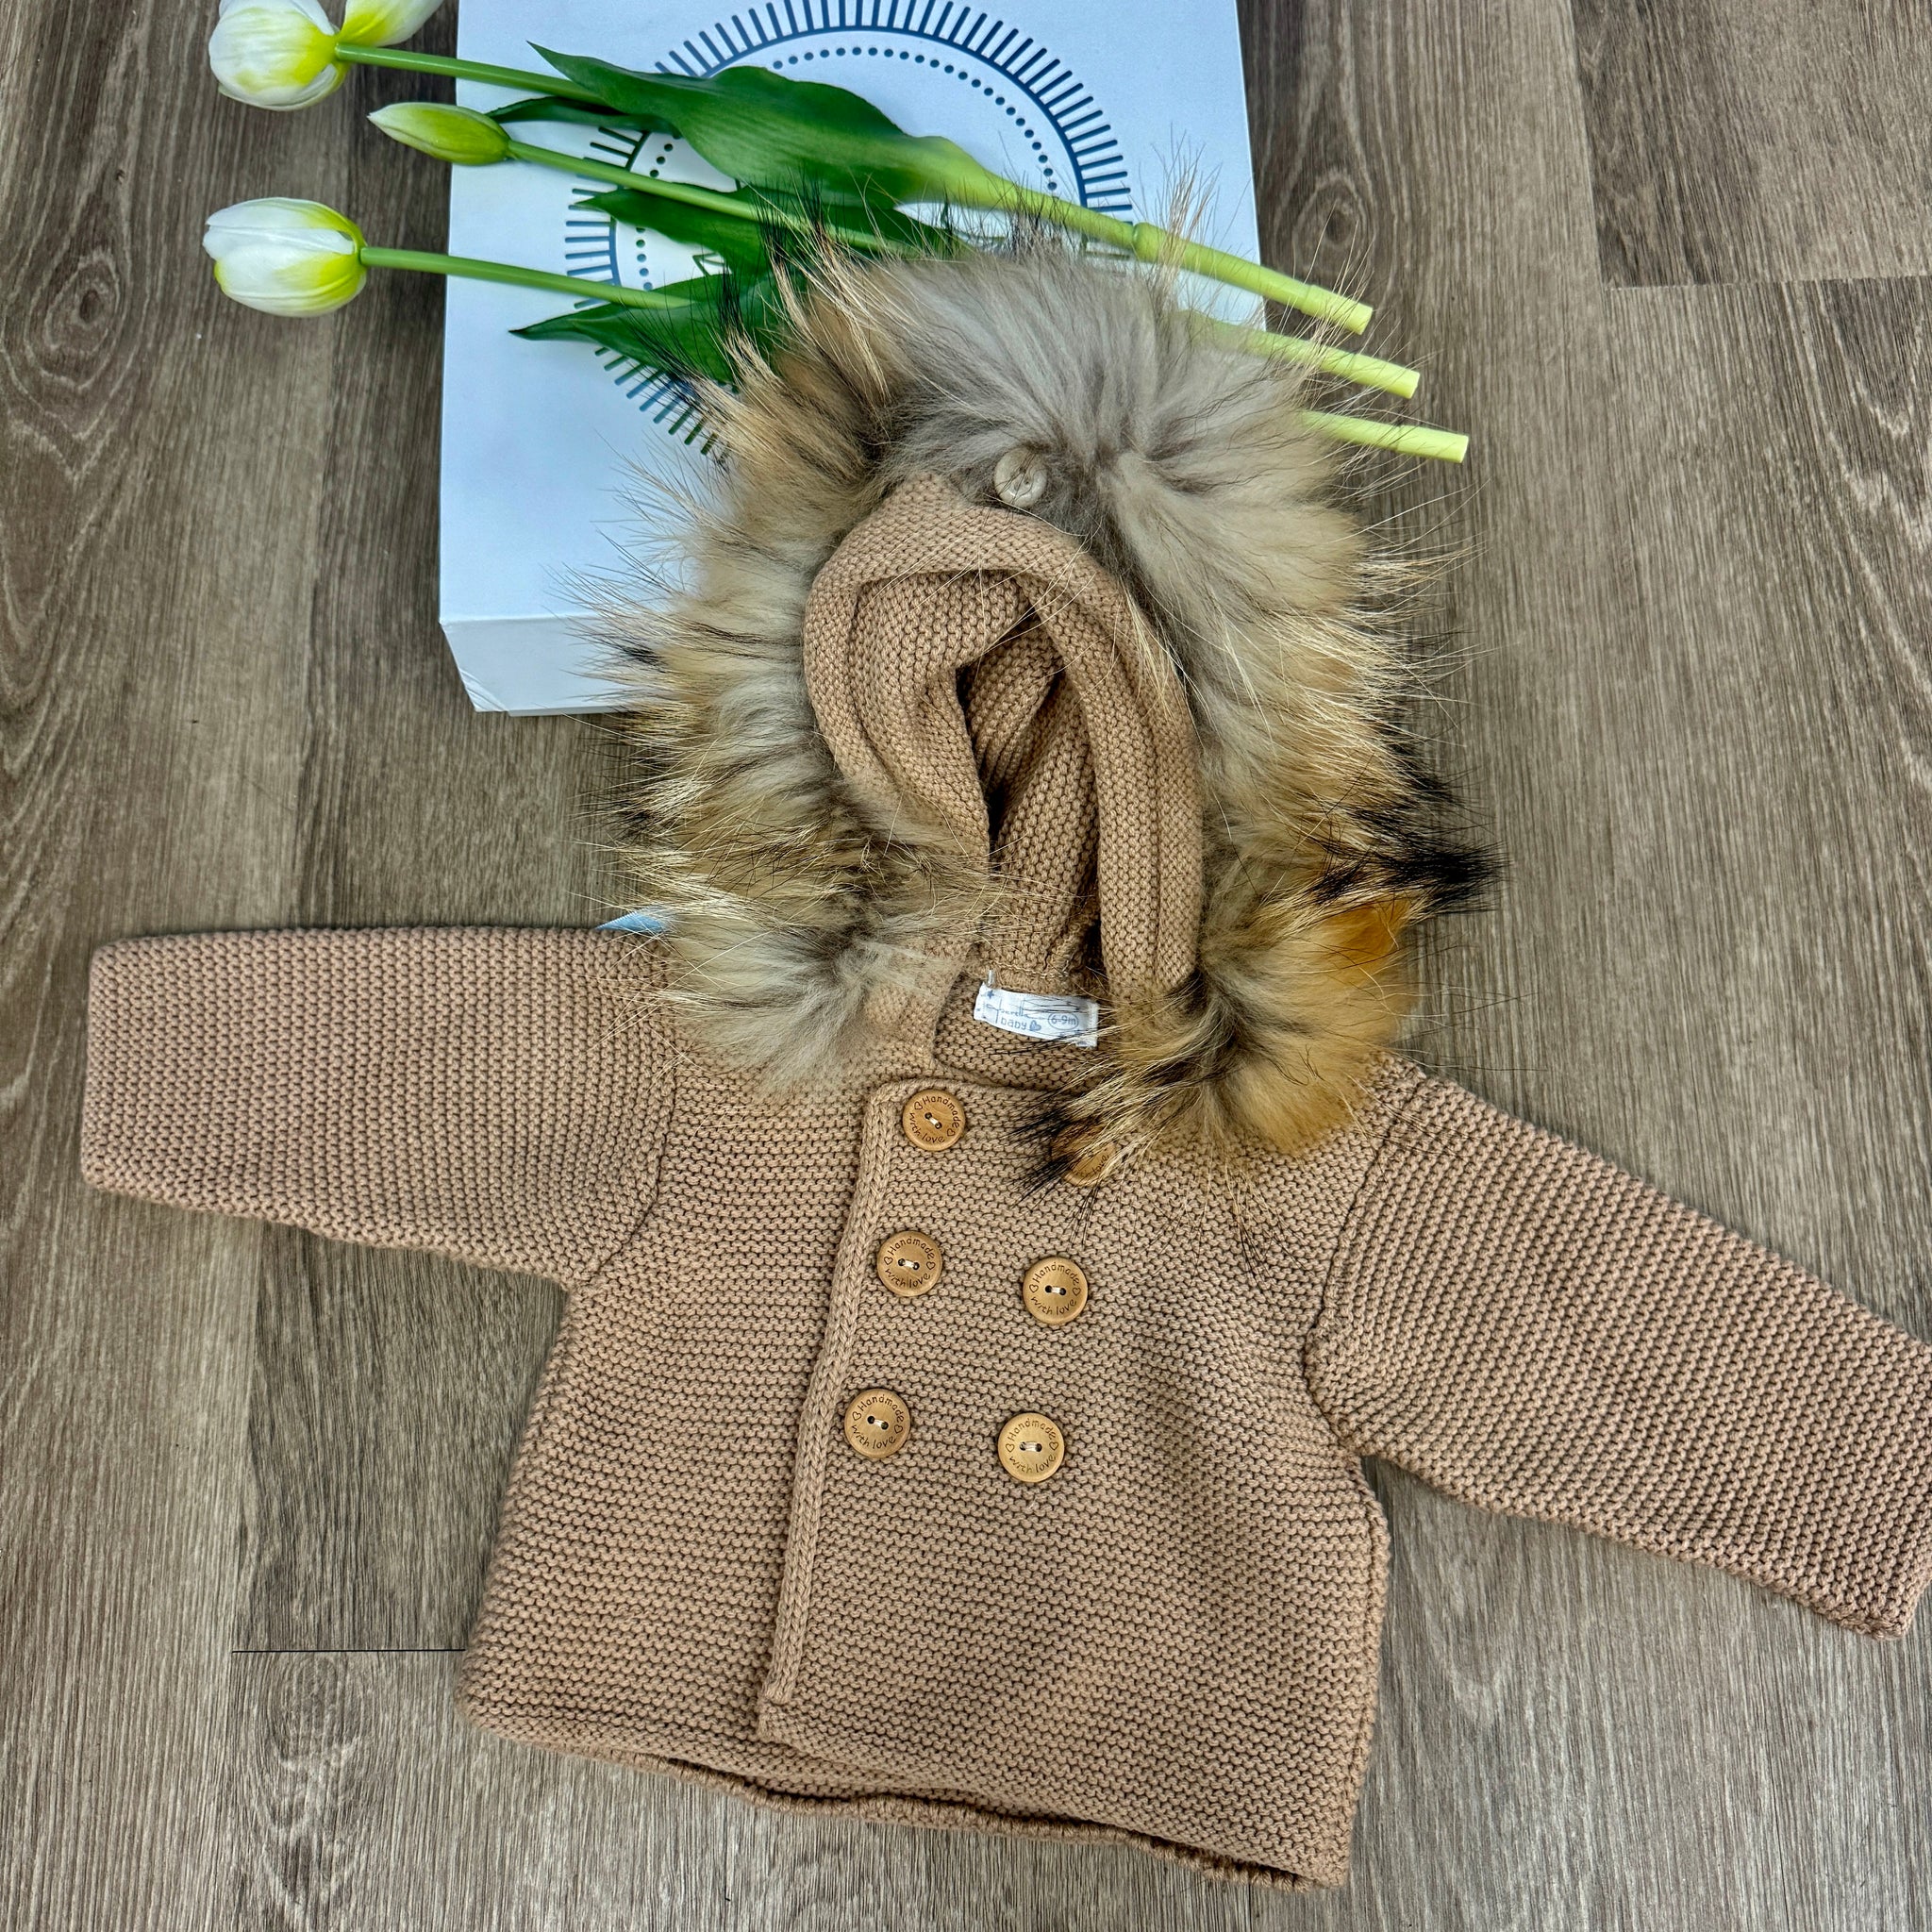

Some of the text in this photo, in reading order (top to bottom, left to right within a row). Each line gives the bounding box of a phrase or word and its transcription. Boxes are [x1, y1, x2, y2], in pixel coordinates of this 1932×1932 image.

[1000, 1017, 1027, 1030] baby
[922, 1095, 961, 1128] Handmade
[909, 1112, 945, 1143] with love
[887, 1235, 935, 1260] Handmade
[885, 1268, 931, 1289] with love
[1032, 1261, 1079, 1286] Handmade
[1030, 1296, 1077, 1315] with love
[857, 1393, 905, 1423] Handmade
[851, 1424, 896, 1450] with love
[1007, 1417, 1057, 1441] Handmade
[1008, 1454, 1056, 1474] with love
